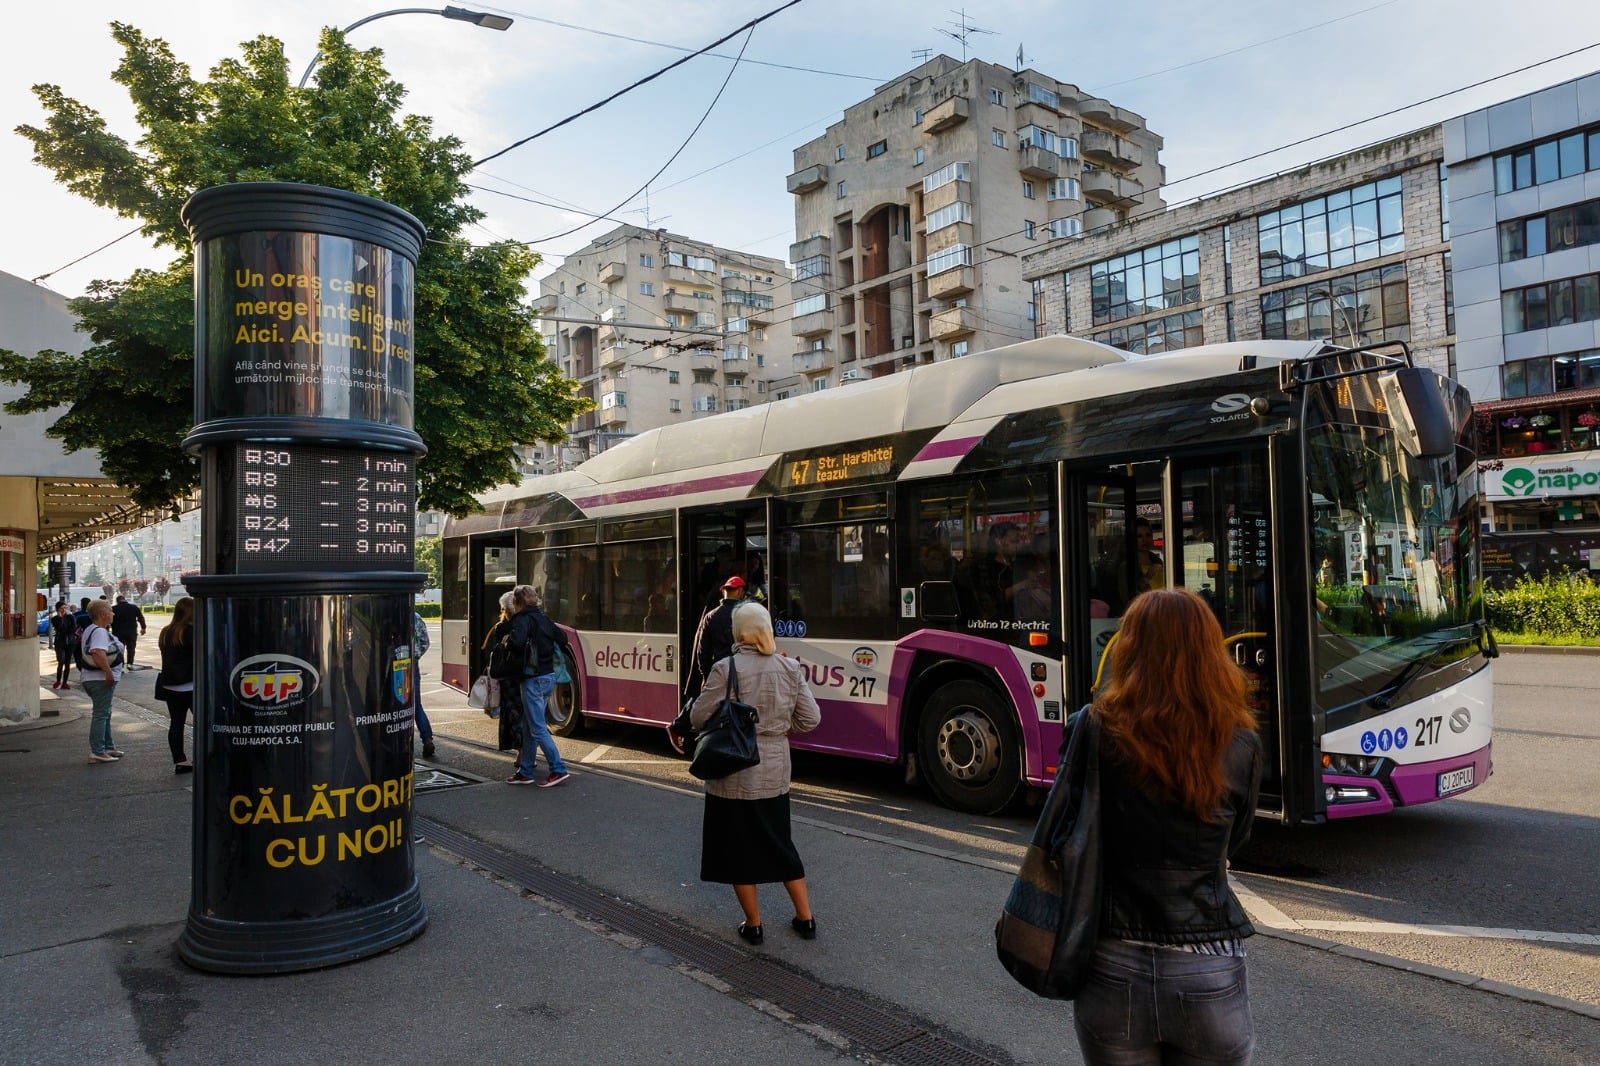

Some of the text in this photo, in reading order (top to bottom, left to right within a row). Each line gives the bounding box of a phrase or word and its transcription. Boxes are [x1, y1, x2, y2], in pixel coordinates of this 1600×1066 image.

[236, 269, 265, 288] Un
[330, 278, 376, 298] care
[236, 300, 308, 321] merge
[235, 323, 285, 344] Aici.
[291, 325, 367, 350] Acum.
[235, 359, 388, 380] Află când vine și unde se duce
[235, 373, 282, 384] următorul
[285, 374, 320, 386] mijloc
[322, 375, 337, 385] de
[340, 376, 383, 393] transport
[1210, 412, 1250, 424] SOLARIS
[264, 451, 291, 466] 30
[363, 457, 370, 471] 1
[376, 459, 407, 473] min
[791, 446, 893, 485] 47 Str. Harghitei
[1538, 466, 1574, 475] farmacia
[263, 473, 277, 487] 8
[357, 477, 369, 491] 2
[376, 479, 407, 493] min
[816, 467, 848, 482] teazul
[1538, 472, 1600, 491] napo
[263, 495, 277, 509] 6
[357, 498, 369, 512] 3
[376, 500, 407, 513] min
[263, 516, 290, 531] 24
[357, 519, 369, 533] 3
[376, 520, 407, 533] min
[263, 538, 290, 552] 47
[357, 539, 369, 553] 9
[376, 540, 407, 553] min
[967, 619, 1051, 631] Urbino 12 electric
[595, 644, 662, 672] electric
[849, 675, 877, 698] 217
[242, 725, 252, 734] DE
[254, 724, 303, 734] TRANSPORT
[304, 721, 336, 732] PUBLIC
[355, 712, 392, 726] PRIMĂRIA
[232, 735, 303, 746] CLUJ-NAPOCA S.A.
[1414, 715, 1443, 747] 217
[1441, 775, 1451, 791] CJ
[265, 818, 402, 869] CU NOI!
